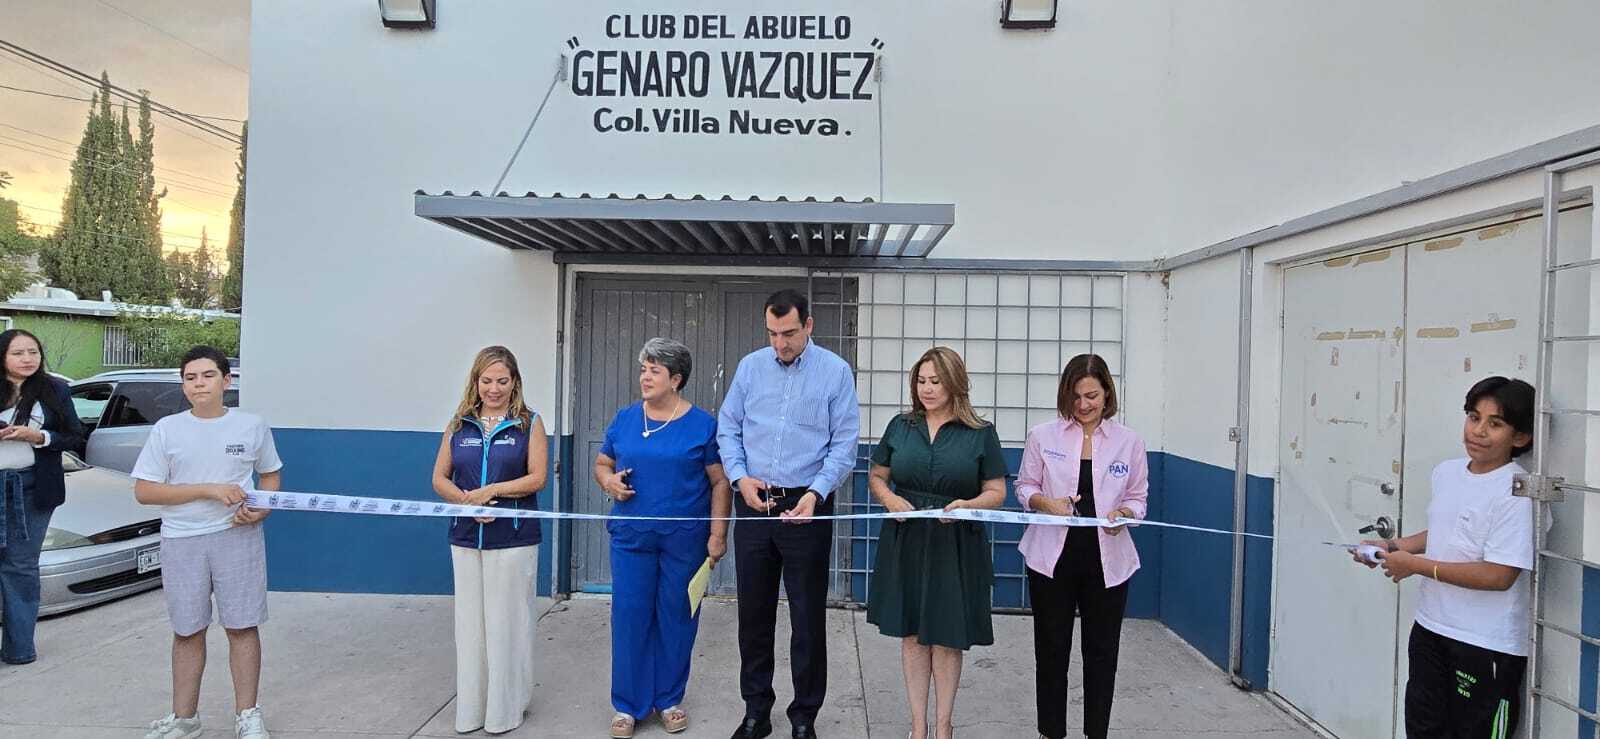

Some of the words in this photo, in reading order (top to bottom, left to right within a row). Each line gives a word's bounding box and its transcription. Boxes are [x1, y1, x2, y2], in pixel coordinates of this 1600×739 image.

[605, 14, 676, 39] CLUB
[683, 14, 736, 39] DEL
[743, 15, 851, 40] ABUELO
[1109, 464, 1129, 474] PAN
